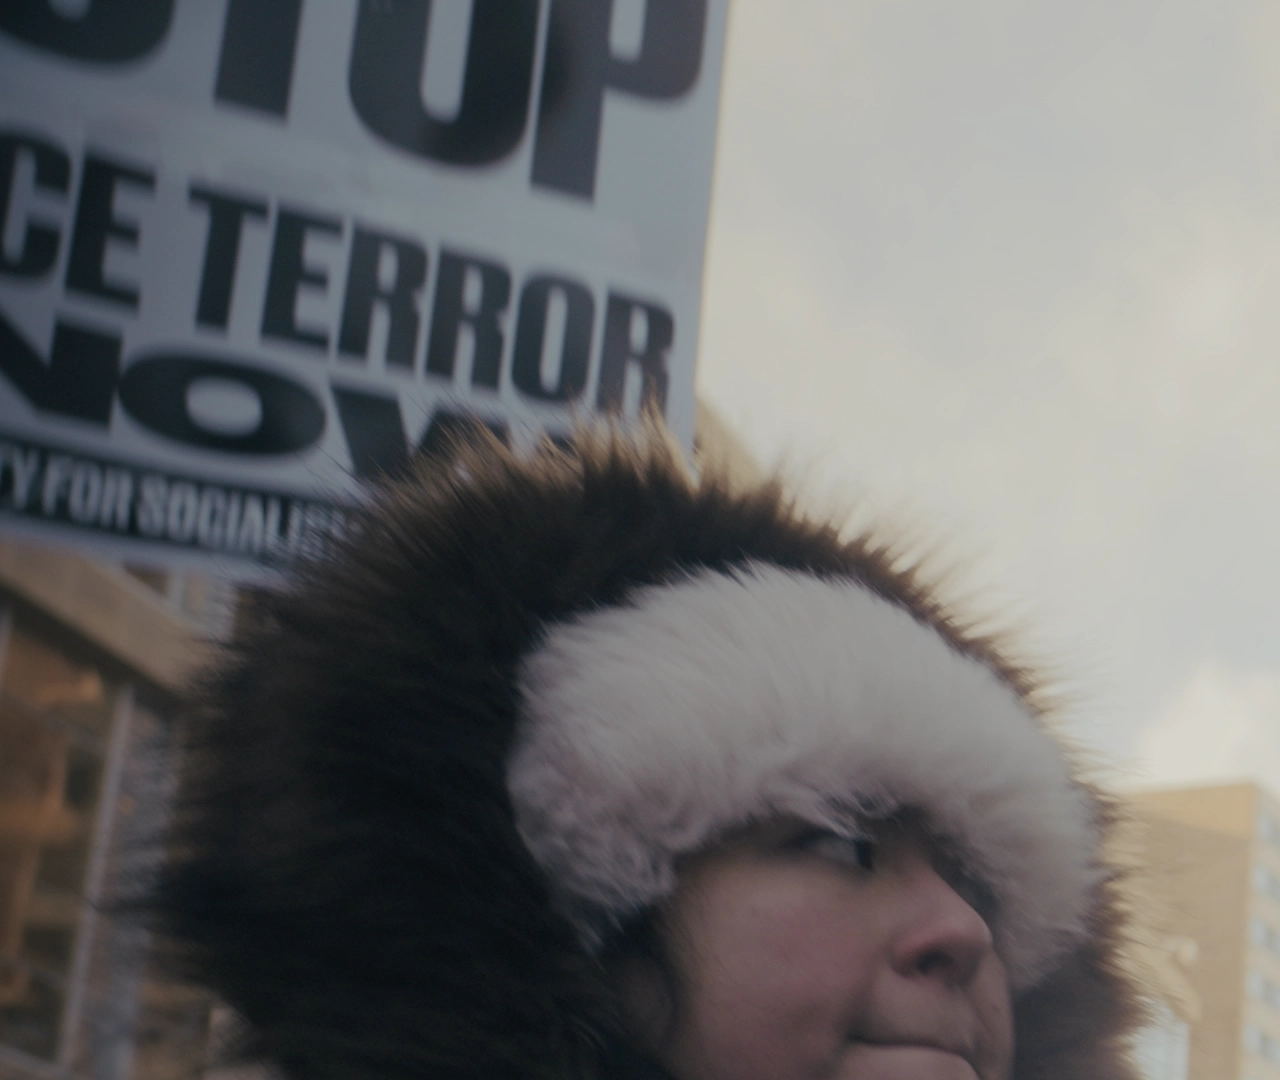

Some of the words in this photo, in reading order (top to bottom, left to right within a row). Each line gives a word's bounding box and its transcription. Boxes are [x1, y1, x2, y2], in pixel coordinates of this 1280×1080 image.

[188, 184, 676, 414] TERROR
[42, 454, 133, 526] FOR
[136, 474, 350, 562] SOCIALI
